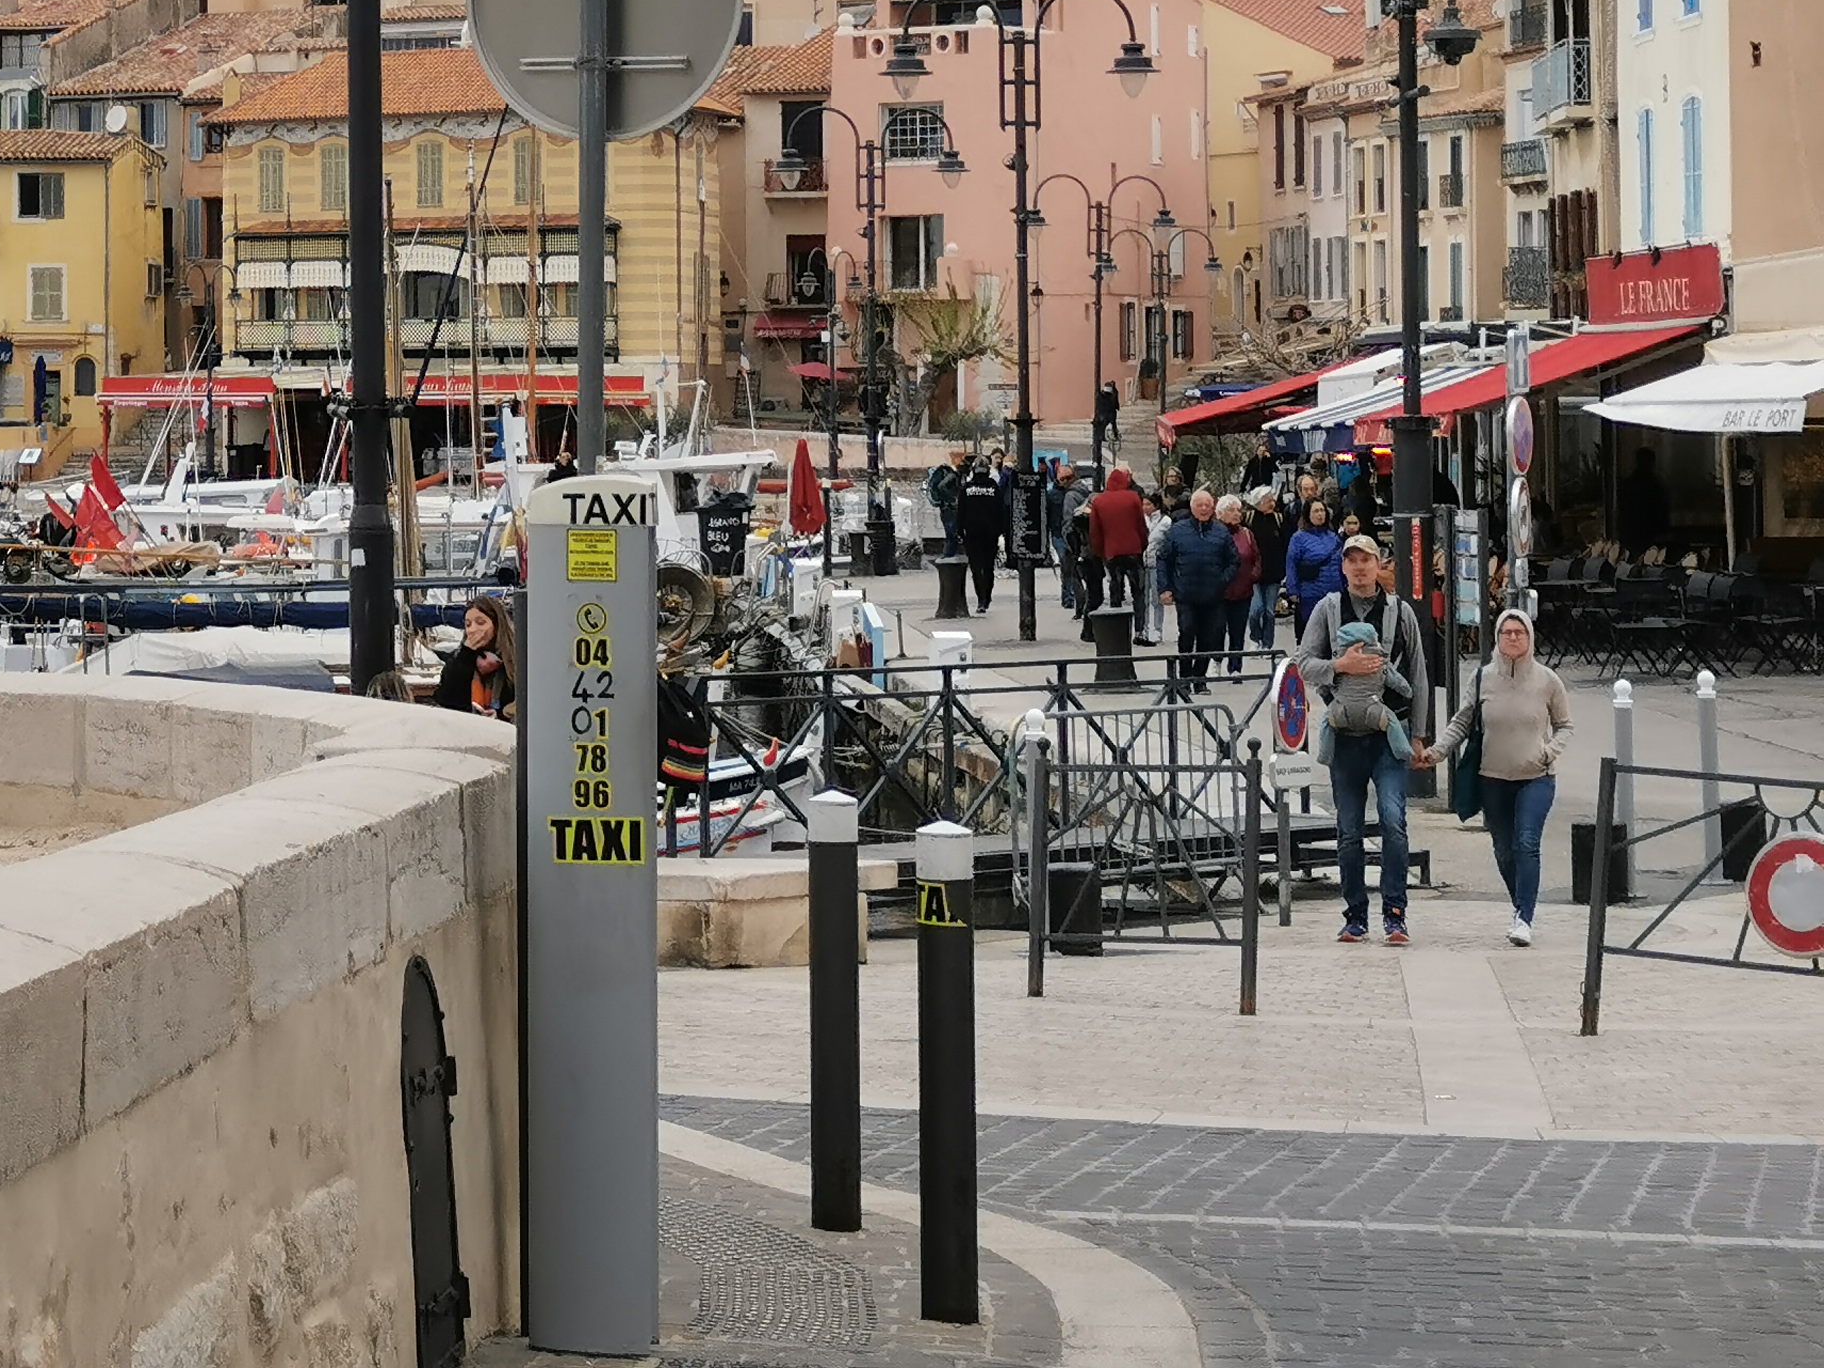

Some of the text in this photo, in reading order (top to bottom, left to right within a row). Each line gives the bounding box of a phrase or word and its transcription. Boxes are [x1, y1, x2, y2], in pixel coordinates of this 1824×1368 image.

[1619, 278, 1691, 315] LE FRANCE
[1722, 408, 1797, 428] BAR LE PORT
[562, 493, 647, 526] TAXI
[707, 531, 729, 542] BLEU
[576, 637, 609, 666] 04
[571, 670, 615, 704] 42
[571, 705, 607, 738] 01
[576, 744, 606, 773] 78
[574, 779, 609, 808] 96
[550, 819, 641, 861] TAXI
